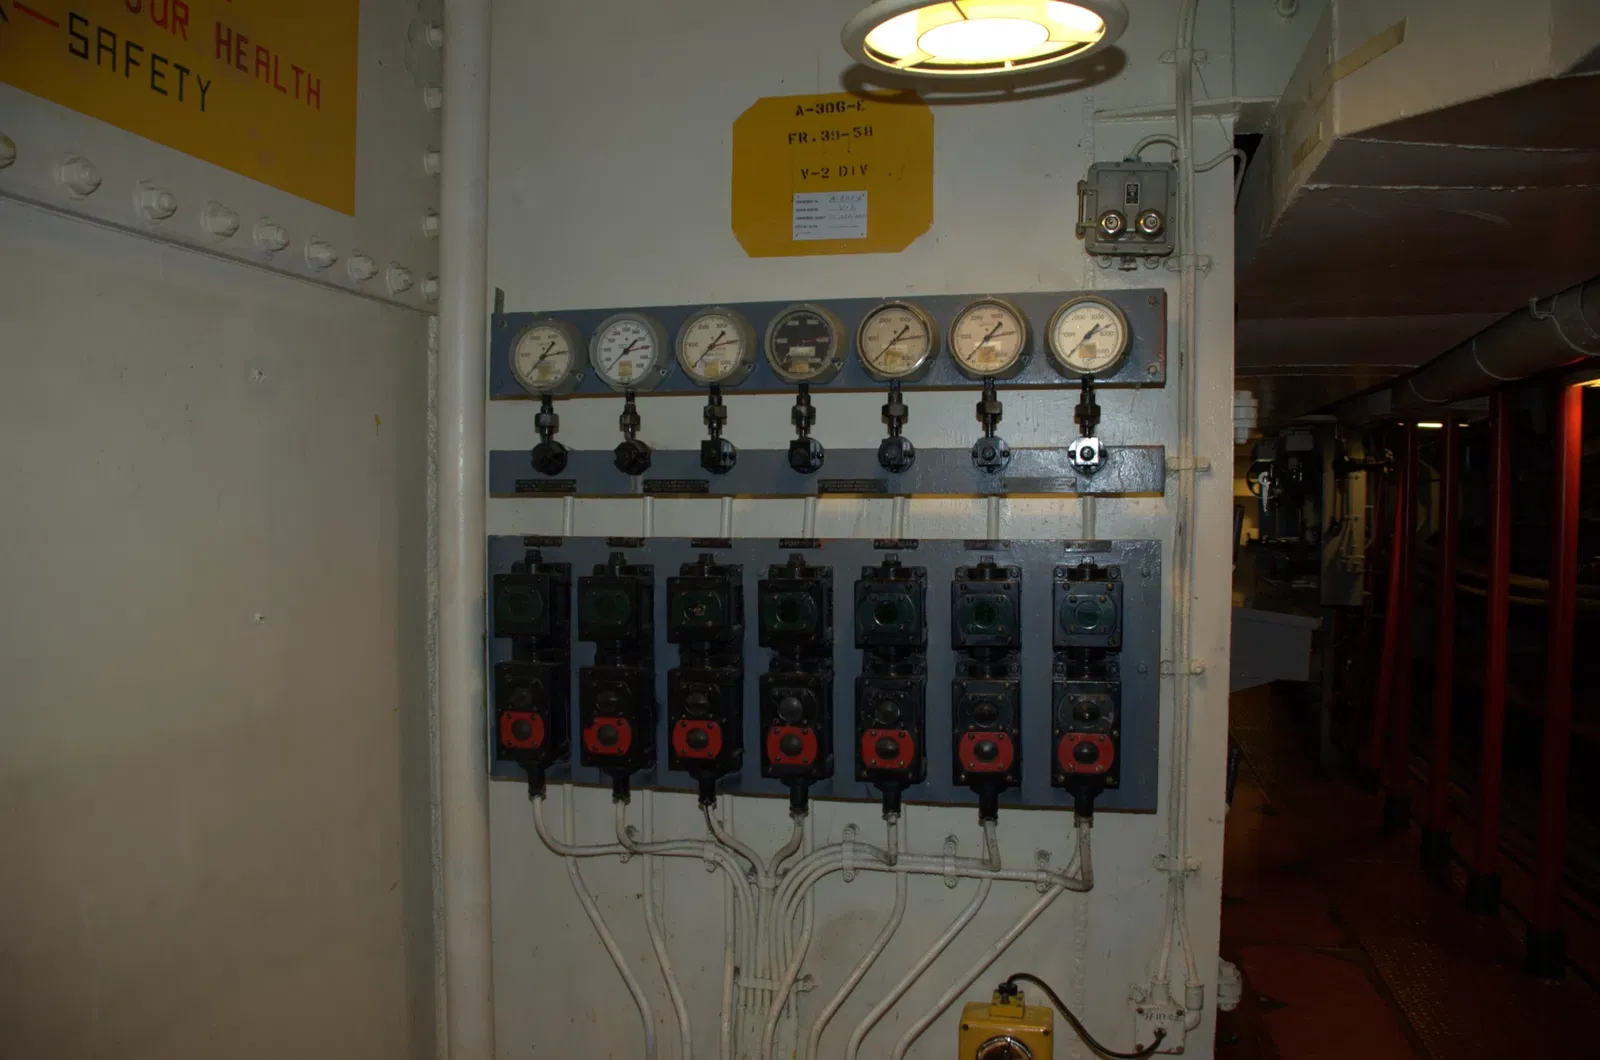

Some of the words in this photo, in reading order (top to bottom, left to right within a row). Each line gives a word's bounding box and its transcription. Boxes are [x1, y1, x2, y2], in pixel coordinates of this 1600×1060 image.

[69, 12, 211, 112] SAFETY
[215, 21, 321, 111] HEALTH
[800, 167, 830, 180] V-2
[838, 164, 868, 177] DIV
